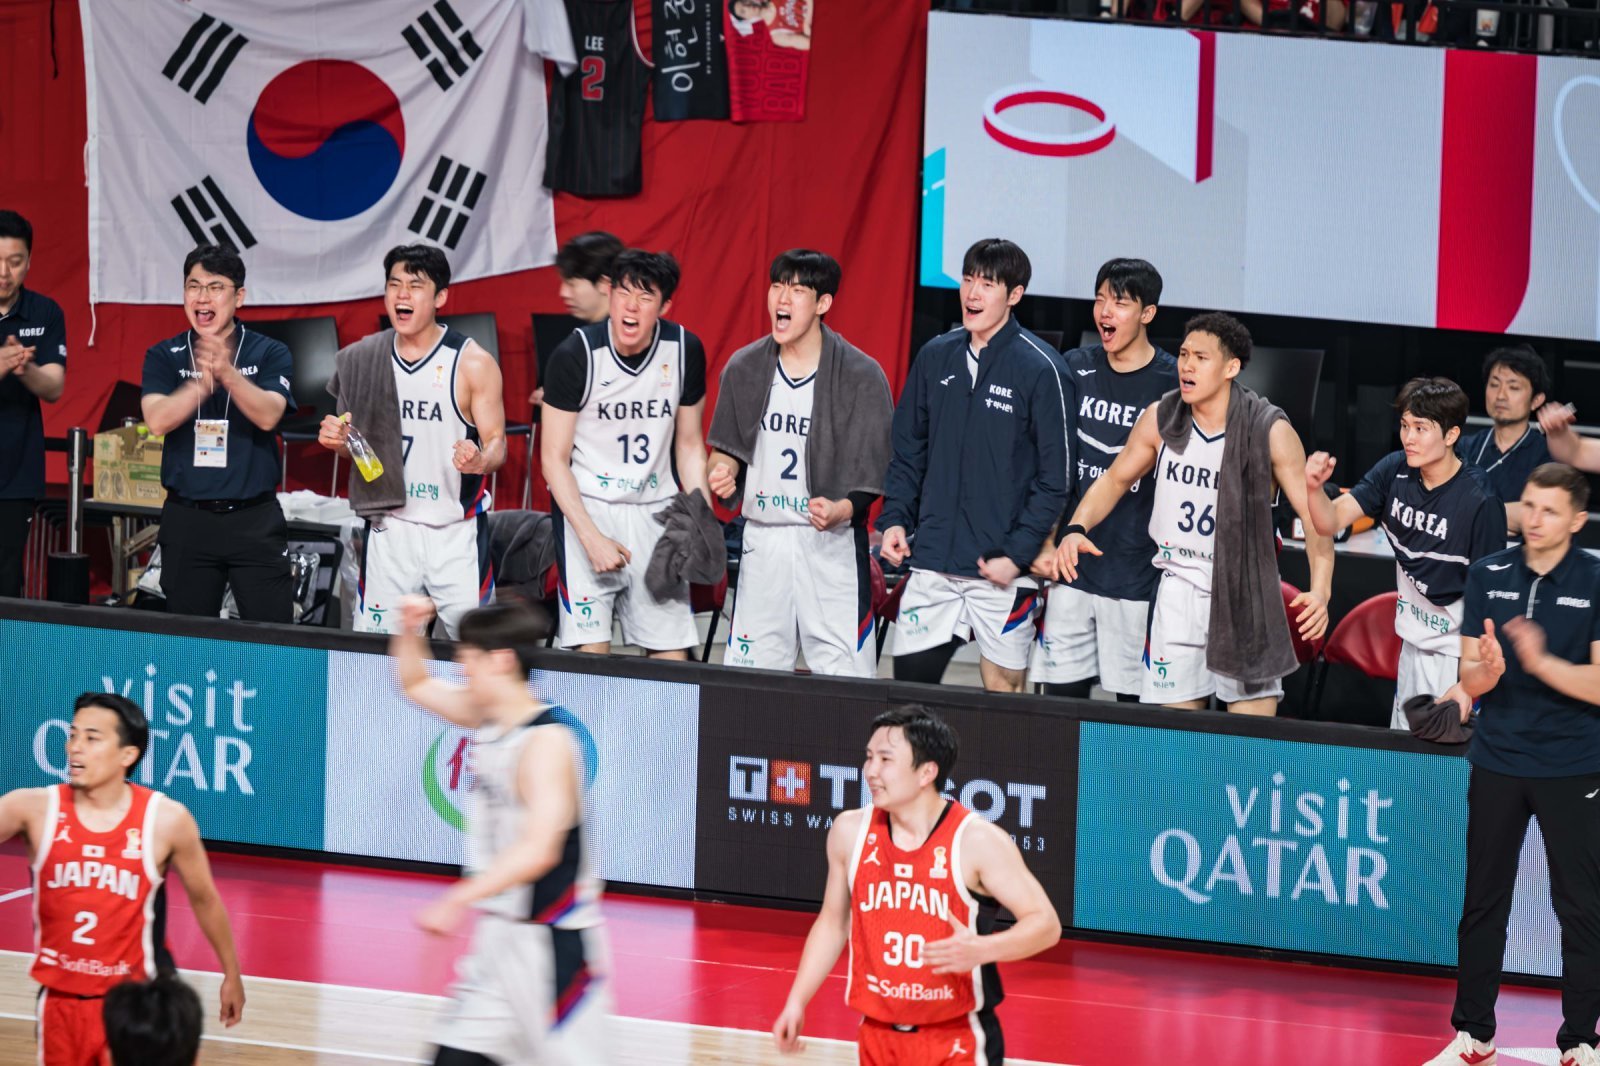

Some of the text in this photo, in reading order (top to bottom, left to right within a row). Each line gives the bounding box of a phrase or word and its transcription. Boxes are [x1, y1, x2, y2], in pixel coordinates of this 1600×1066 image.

[584, 35, 604, 51] LEE
[580, 55, 606, 101] 2
[989, 384, 1013, 398] KORE
[402, 400, 443, 422] REA
[597, 399, 672, 420] KOREA
[401, 435, 414, 466] 7
[617, 434, 650, 464] 13
[780, 448, 798, 480] 2
[1166, 461, 1218, 490] KOR
[772, 494, 809, 514] 하나은
[1178, 501, 1216, 536] 36
[1390, 497, 1448, 541] KOREA
[33, 718, 255, 796] QTAR
[819, 764, 1046, 828] TIOT
[1226, 771, 1393, 843] visit
[728, 806, 793, 827] SWISS
[47, 861, 140, 900] JAPAN
[1150, 828, 1390, 910] QATAR
[860, 881, 948, 921] JAPAN
[72, 910, 98, 946] 2
[58, 953, 131, 976] SoftBank
[883, 931, 926, 969] 30
[879, 979, 954, 1001] SoftBank
